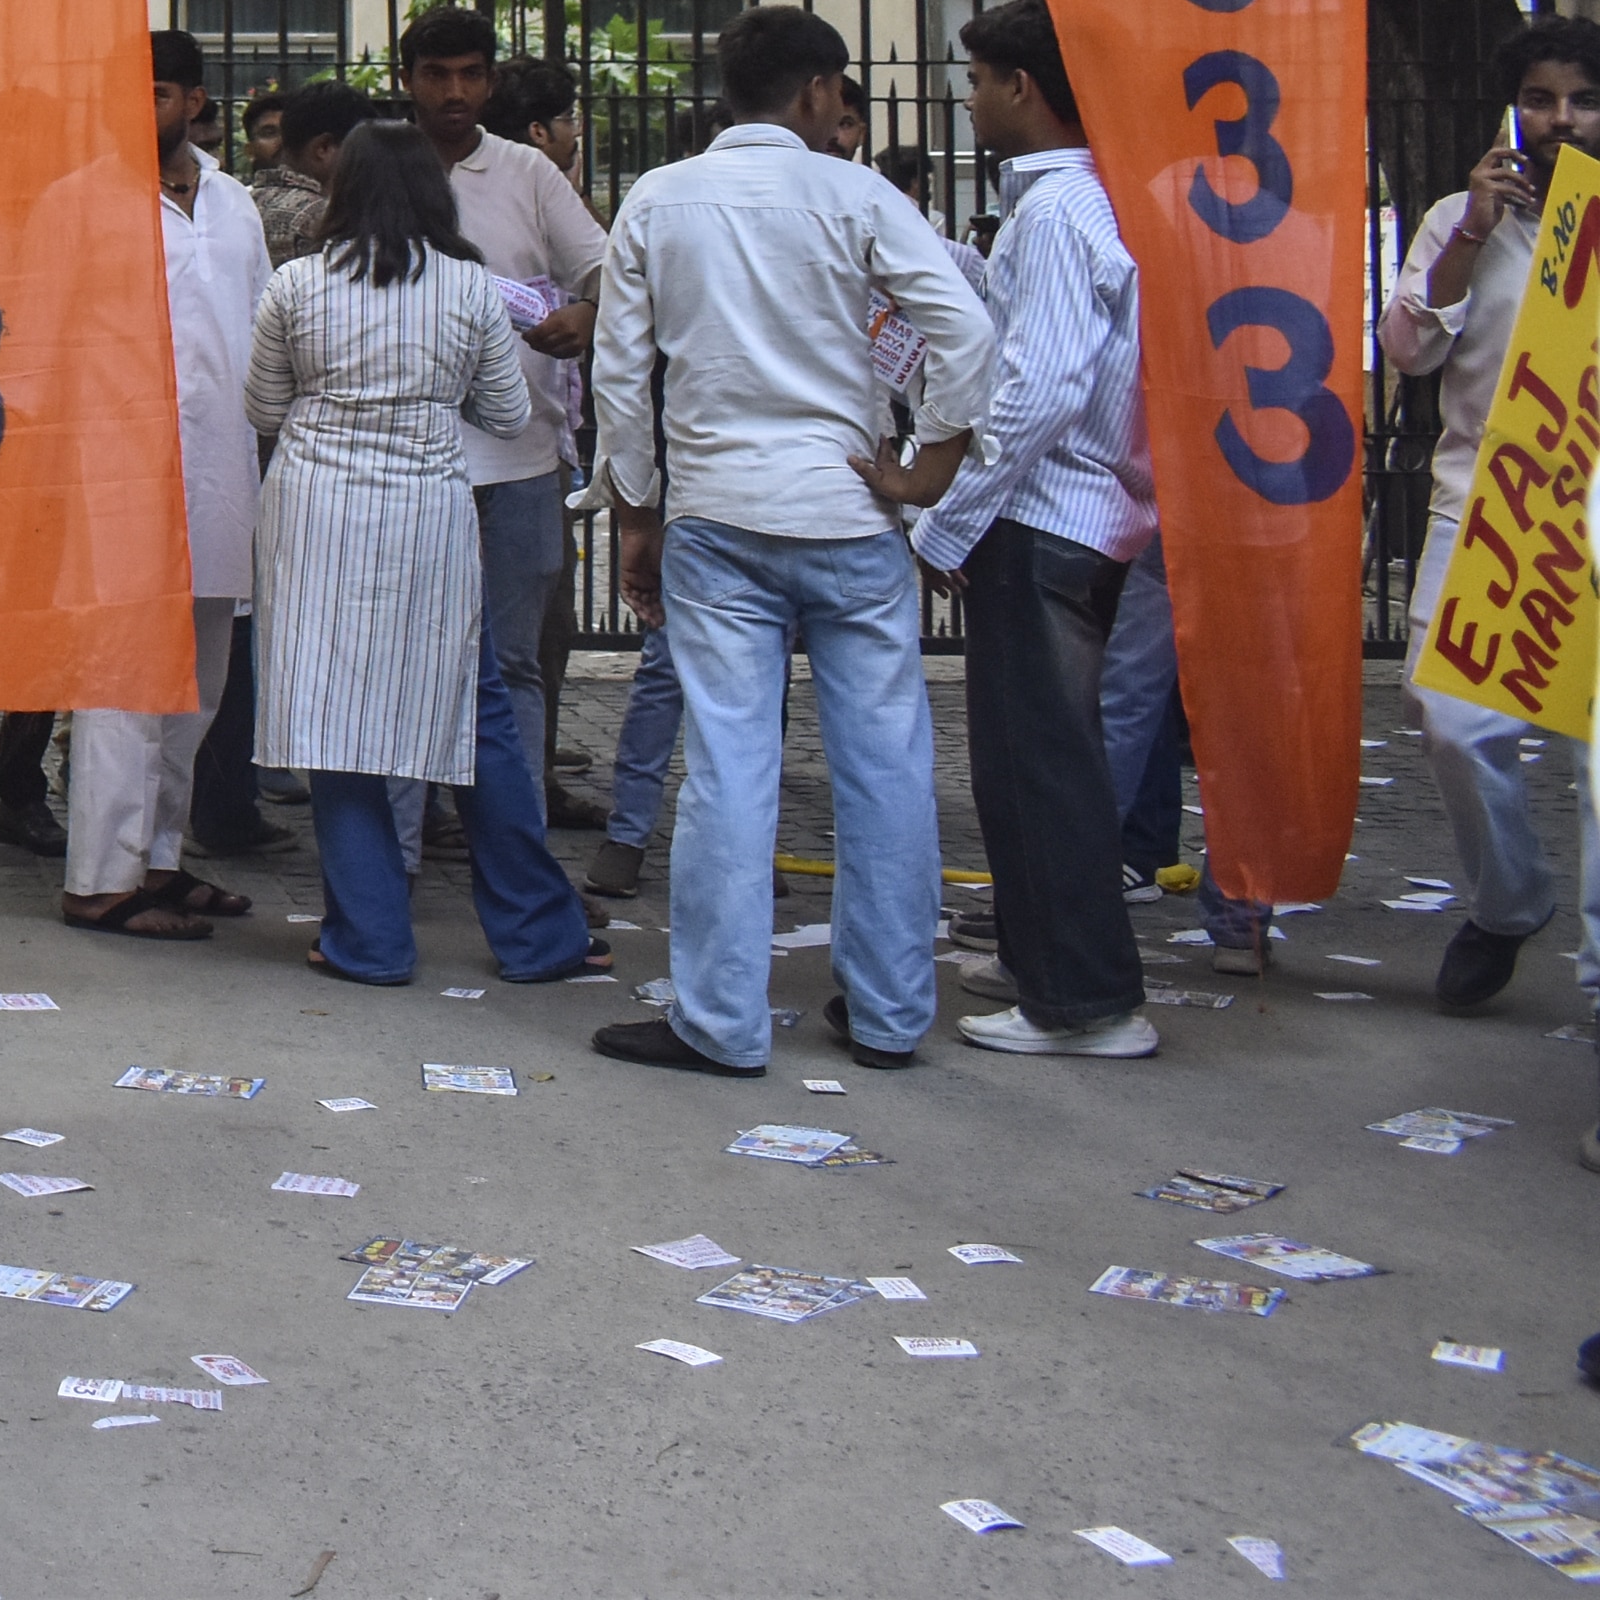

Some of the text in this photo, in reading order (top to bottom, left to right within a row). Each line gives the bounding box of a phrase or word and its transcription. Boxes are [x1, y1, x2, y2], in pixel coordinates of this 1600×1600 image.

[1182, 49, 1294, 245] 3
[1205, 285, 1356, 506] 3
[1436, 351, 1569, 686] EJAJ
